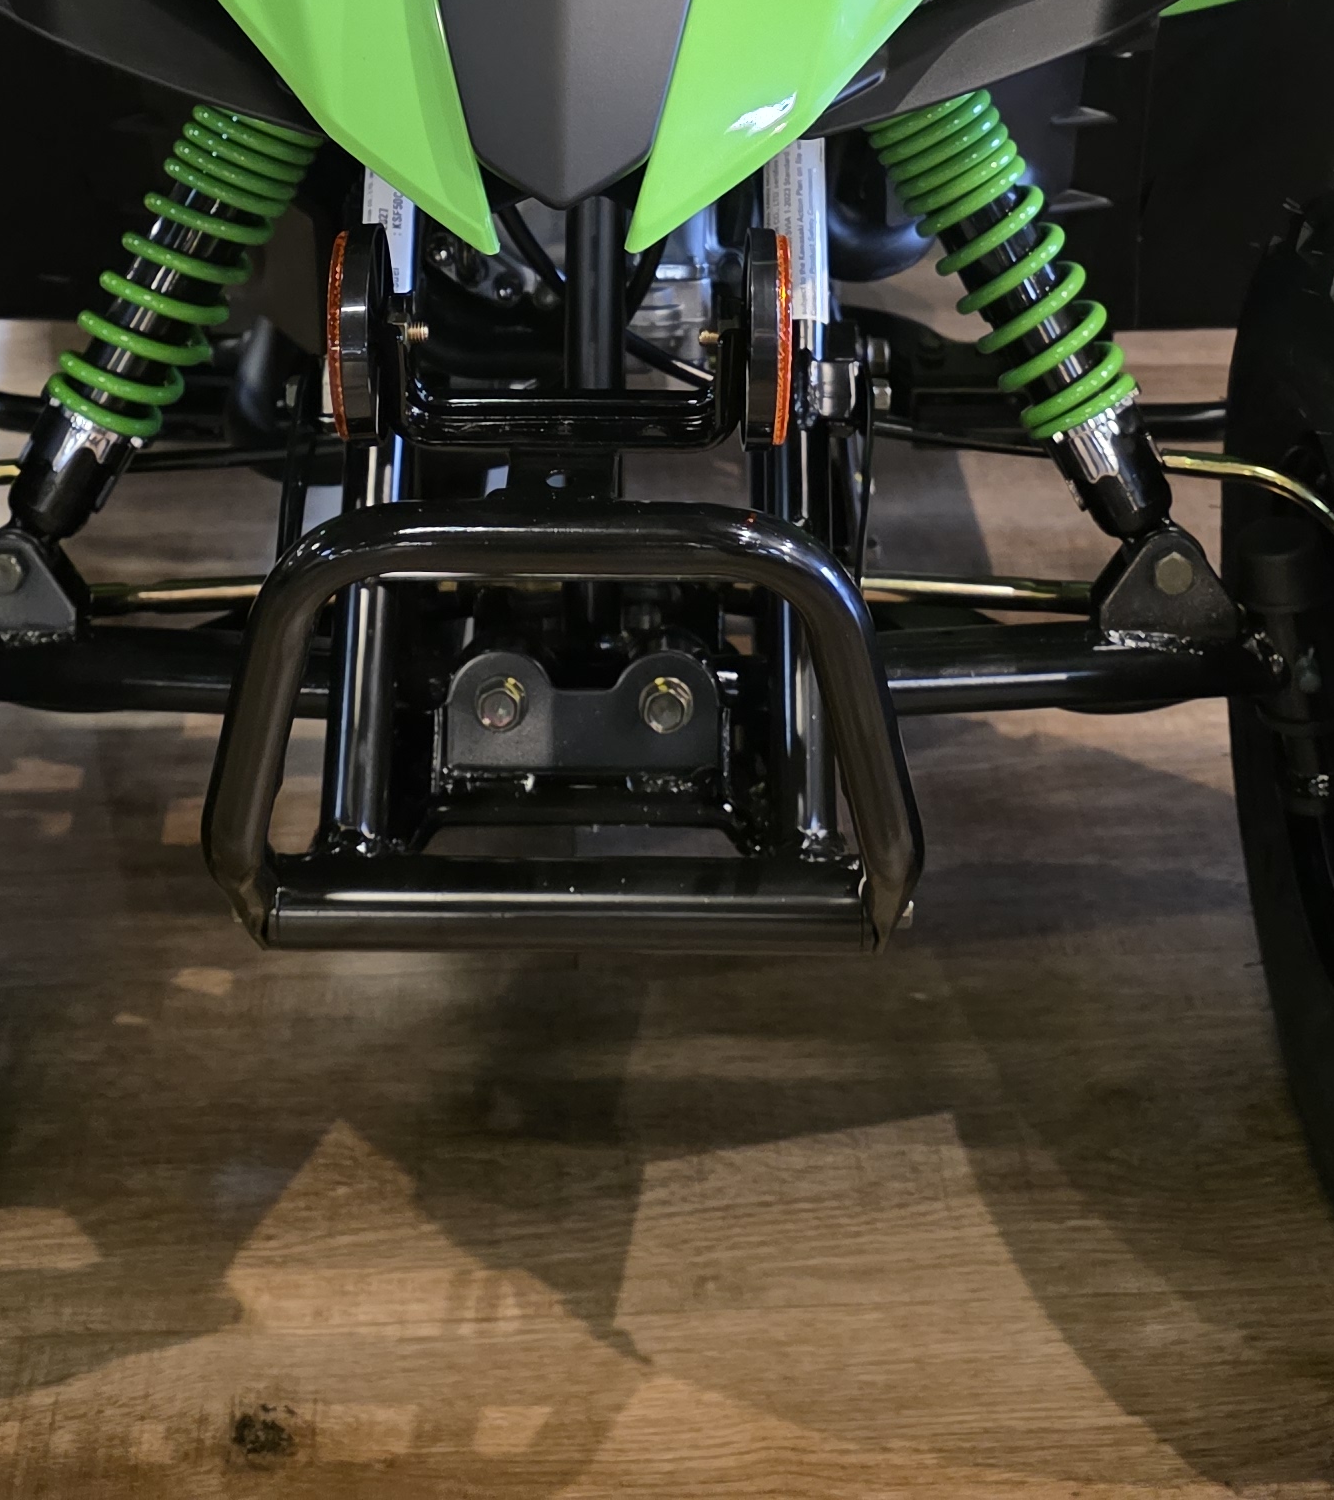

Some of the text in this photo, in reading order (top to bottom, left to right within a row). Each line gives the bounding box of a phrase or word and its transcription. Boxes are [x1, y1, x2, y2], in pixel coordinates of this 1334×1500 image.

[783, 151, 791, 186] Standard
[797, 197, 805, 223] Action
[797, 225, 806, 261] Kawasaki
